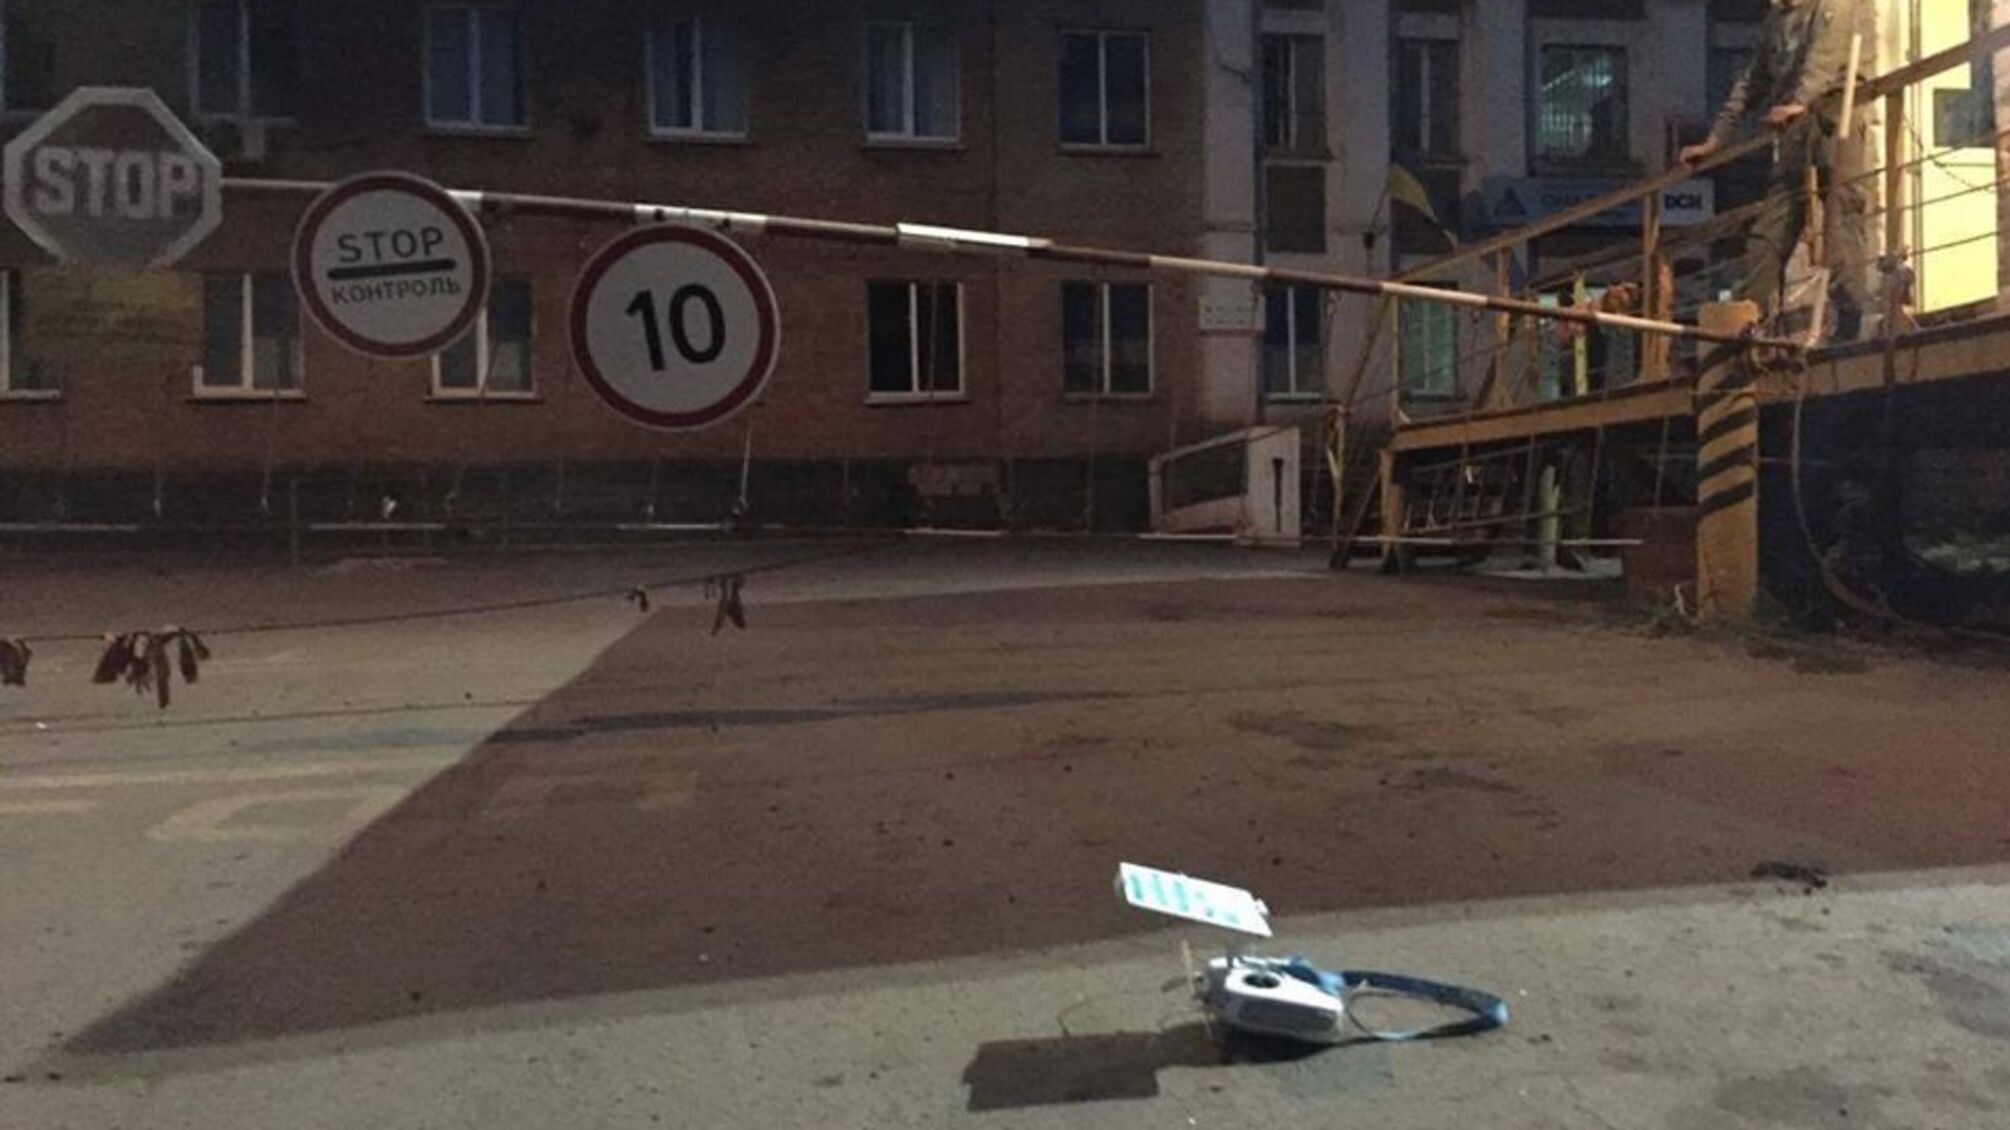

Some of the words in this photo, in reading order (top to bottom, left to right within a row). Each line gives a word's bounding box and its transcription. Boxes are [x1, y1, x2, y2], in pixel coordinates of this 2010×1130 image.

[33, 144, 198, 221] STOP
[336, 226, 443, 264] STOP
[330, 276, 462, 308] КОНТРОЛЬ
[624, 282, 726, 372] 10
